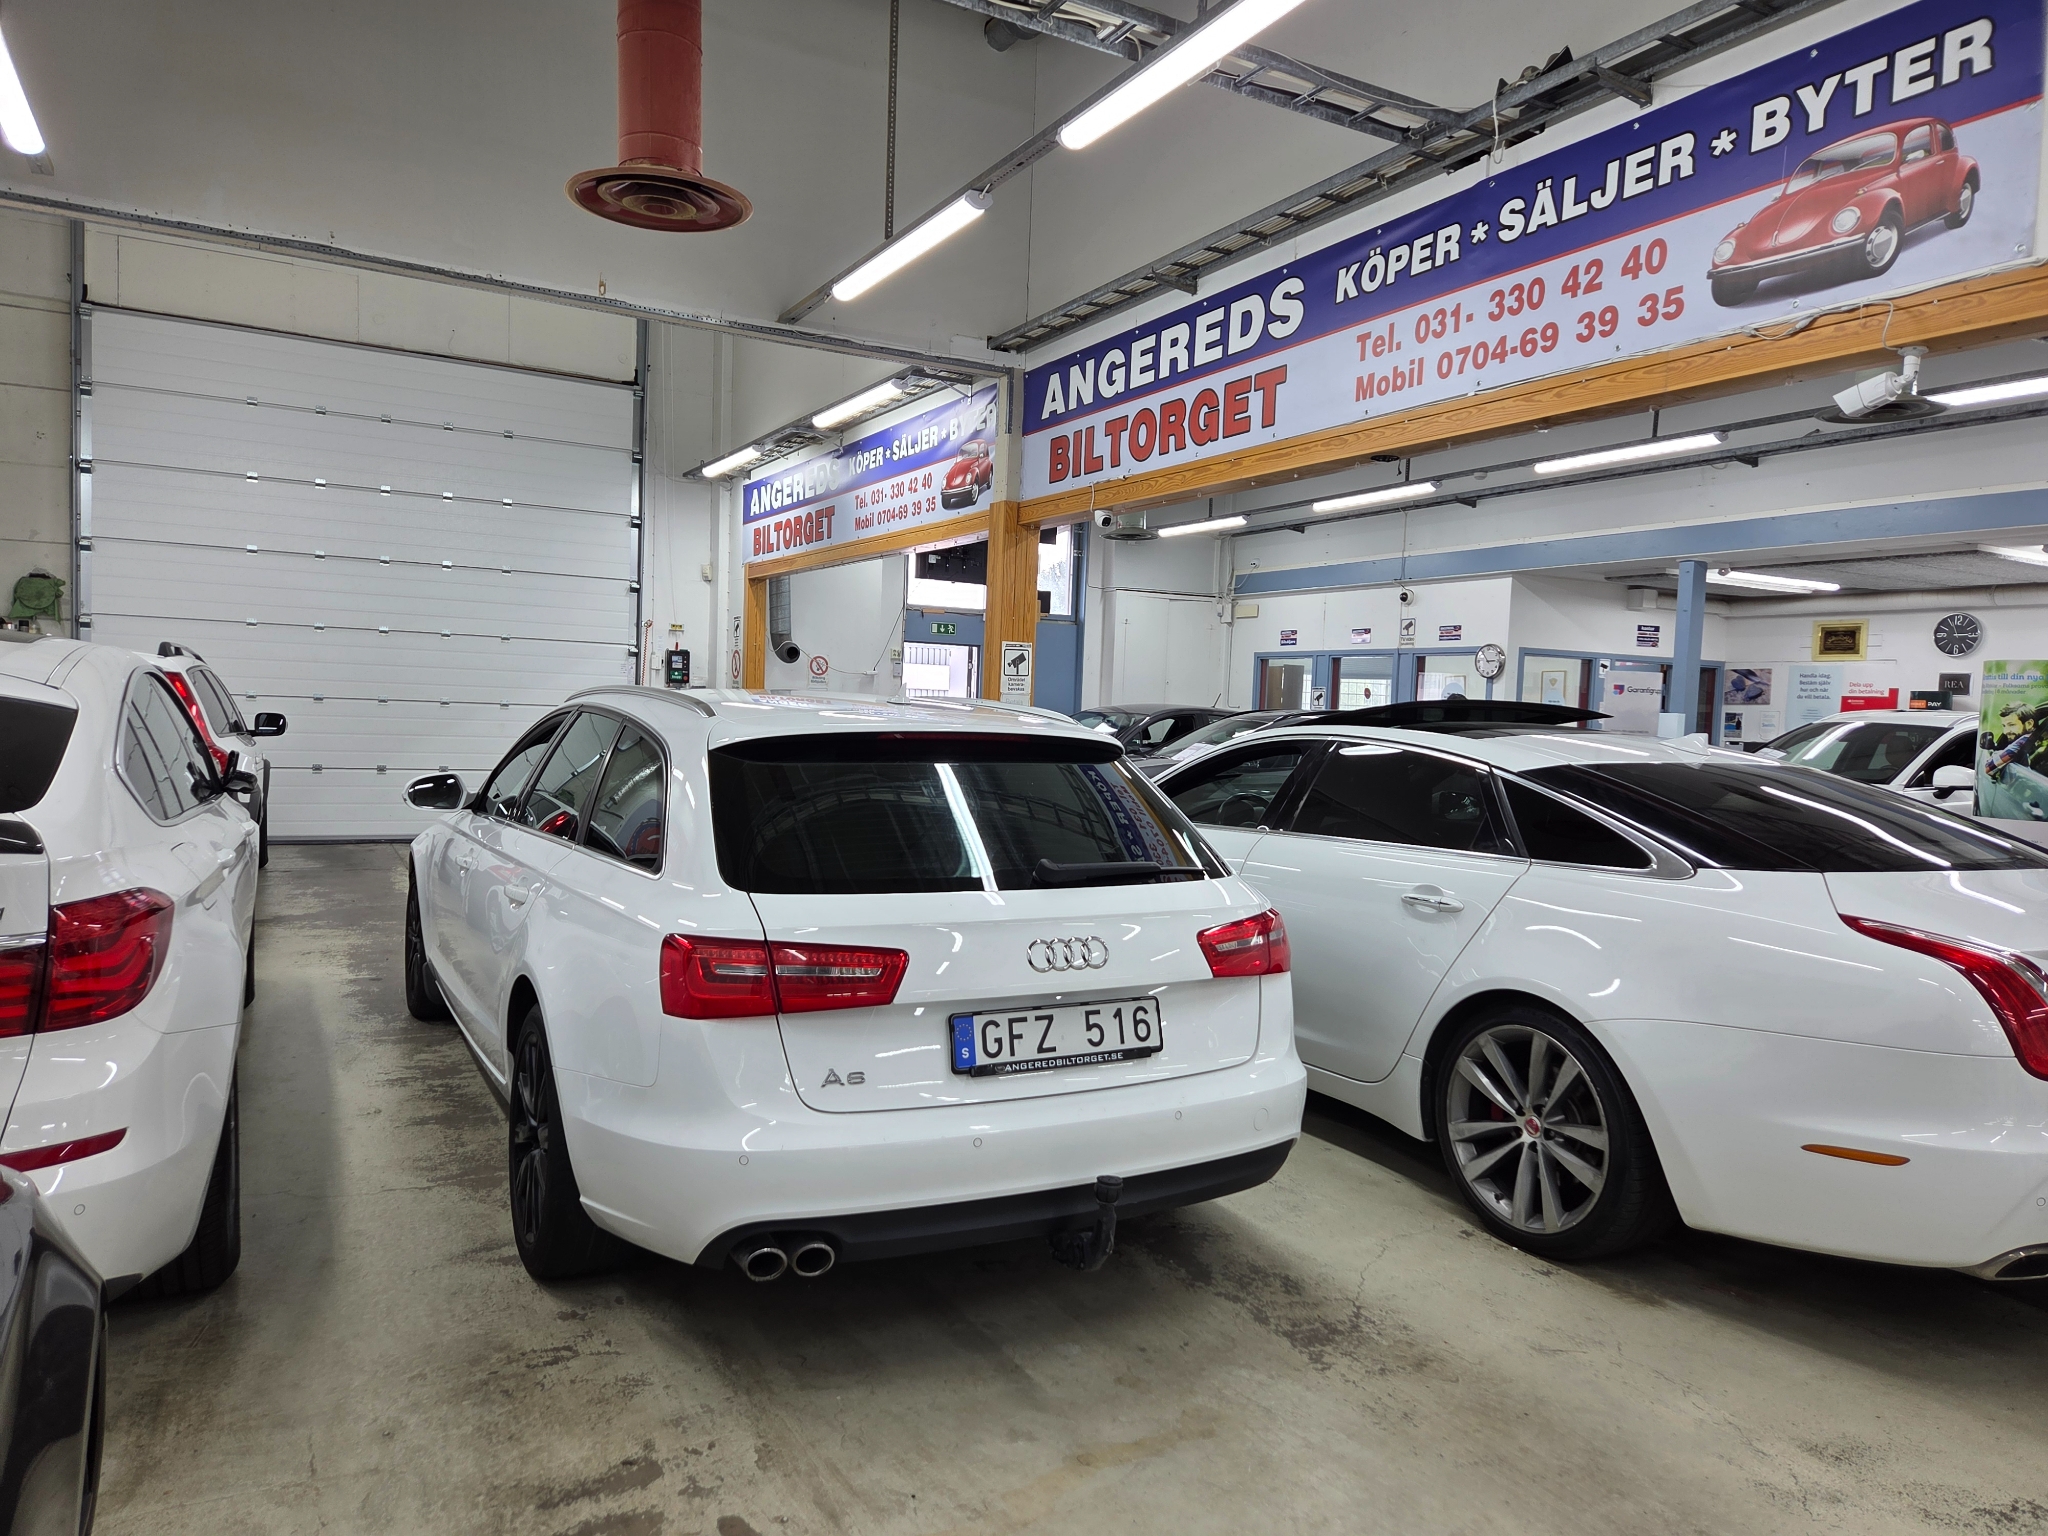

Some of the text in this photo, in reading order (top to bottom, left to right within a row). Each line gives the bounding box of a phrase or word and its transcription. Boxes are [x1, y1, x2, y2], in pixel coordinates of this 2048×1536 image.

[1335, 17, 1994, 304] KÖPER SÄLJER BYTER
[1356, 237, 1668, 362] Tel. 031- 330 42 40
[1040, 277, 1306, 421] ANGEREDS
[1355, 285, 1685, 403] Mobil 0704-69 39 35
[1048, 364, 1288, 485] BILTORGET
[848, 445, 884, 477] KÖPER
[892, 425, 939, 462] SÄLJER
[750, 458, 840, 517] ANGEREDS
[854, 472, 933, 511] Tel. 031- 330 42 40
[854, 495, 936, 532] Mobil 0704-69 39 35
[753, 505, 836, 557] BILTORGET
[1954, 615, 1963, 626] 12
[1953, 645, 1959, 655] 6
[1944, 680, 1964, 689] REA
[960, 1005, 1151, 1059] S GFZ 516
[821, 1068, 866, 1088] A6
[1005, 1051, 1124, 1072] ANGEREDBILTORGET.SE
